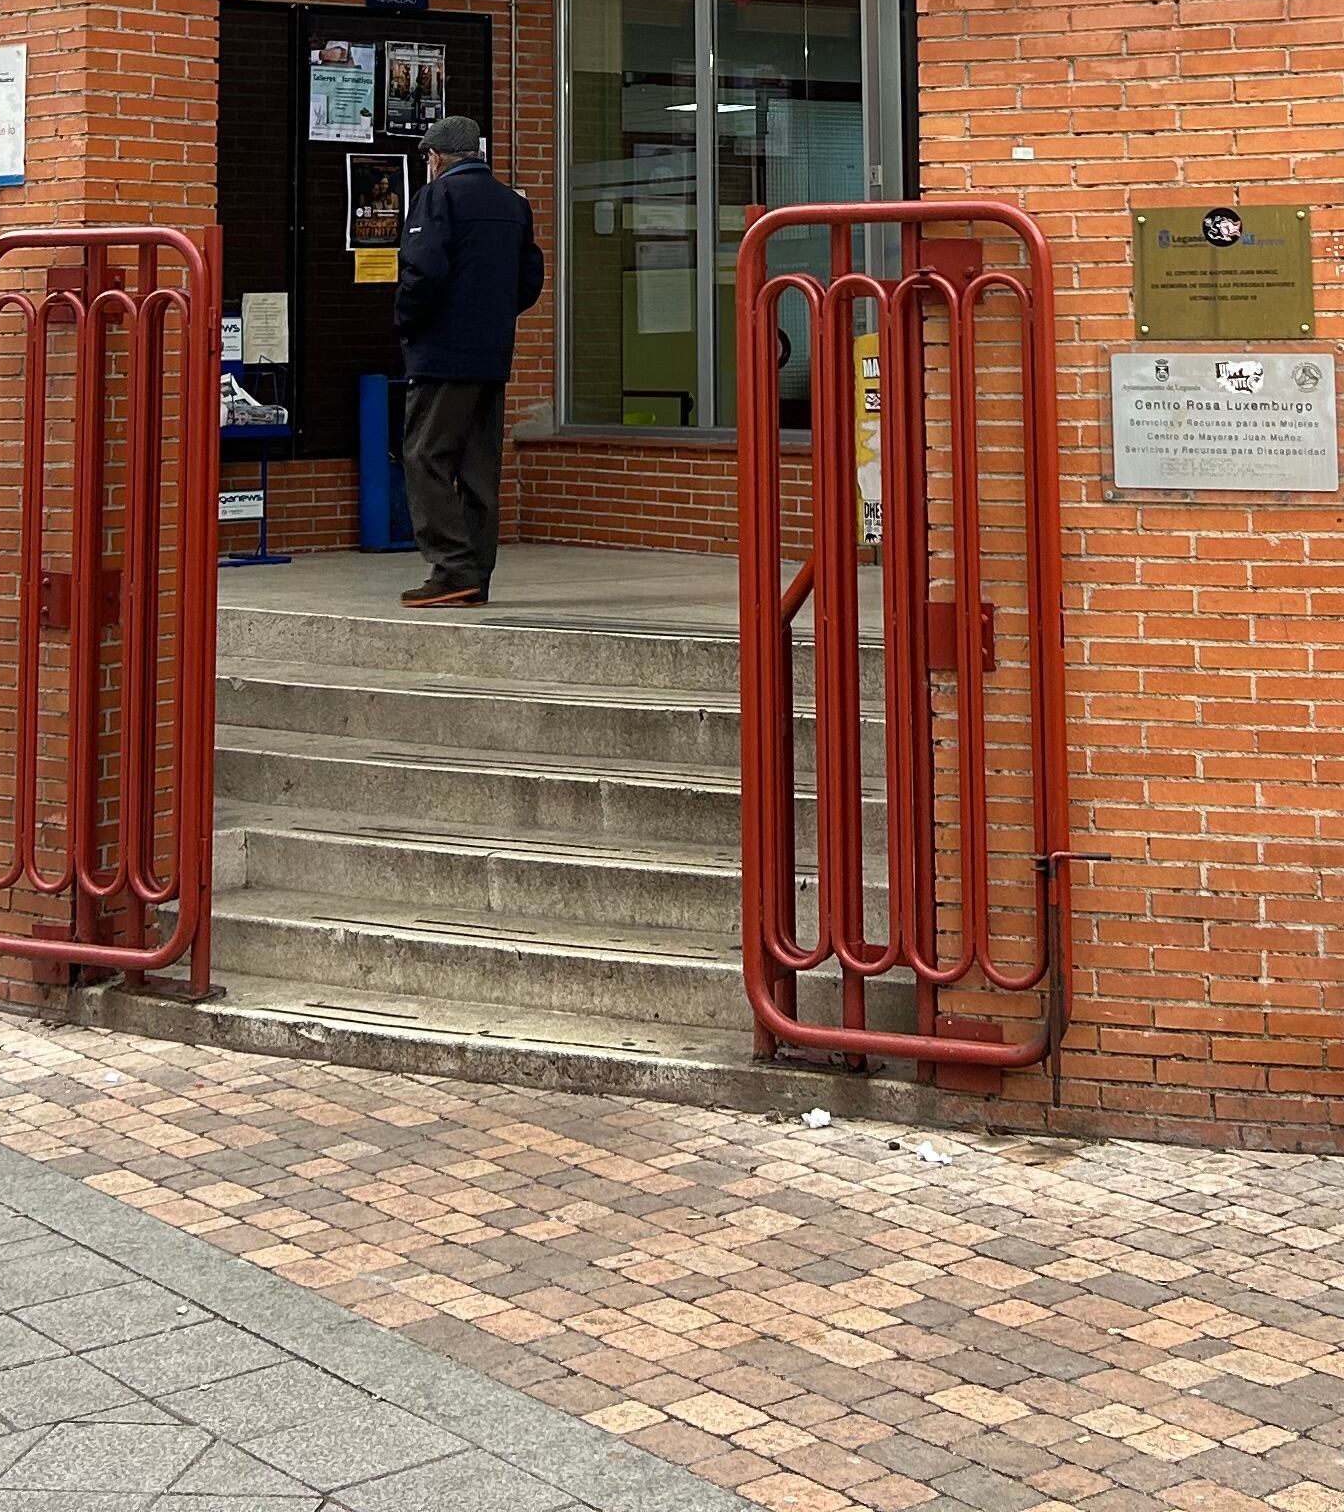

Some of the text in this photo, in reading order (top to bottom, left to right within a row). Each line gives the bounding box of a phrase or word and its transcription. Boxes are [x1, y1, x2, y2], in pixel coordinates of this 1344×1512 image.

[1172, 235, 1206, 245] Legané
[1134, 399, 1313, 414] Centro Rosa Luxemburgo
[1128, 418, 1320, 429] Servicios y Recursos para las Mujeres
[1146, 432, 1303, 443] Centro de Mayores Juan Muñoz
[1125, 445, 1170, 454] Servicios
[1181, 446, 1228, 455] Recursos
[1231, 447, 1253, 456] para
[1257, 447, 1326, 457] Discapacidad
[218, 492, 263, 505] ganews
